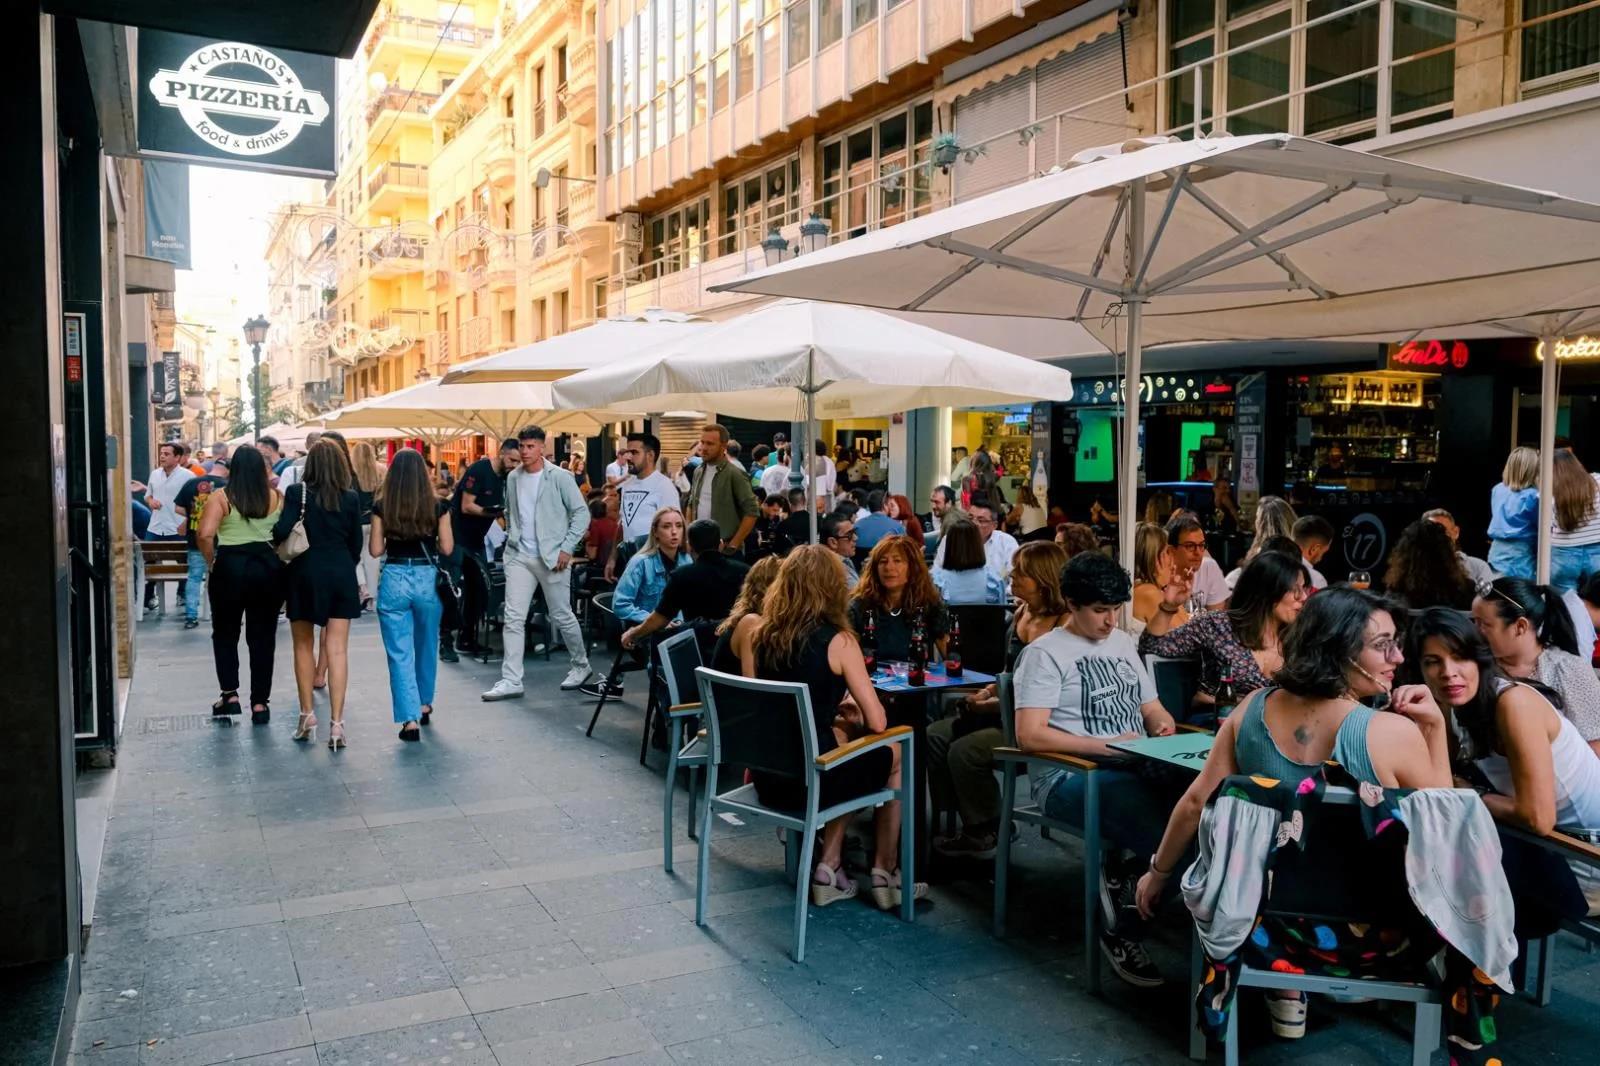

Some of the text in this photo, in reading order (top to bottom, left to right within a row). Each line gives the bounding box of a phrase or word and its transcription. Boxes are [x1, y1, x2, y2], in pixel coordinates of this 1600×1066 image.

[197, 47, 286, 77] CASTAÑOS
[165, 80, 314, 115] PIZZERÍA
[196, 120, 289, 149] food & drinks
[1352, 533, 1377, 560] 17
